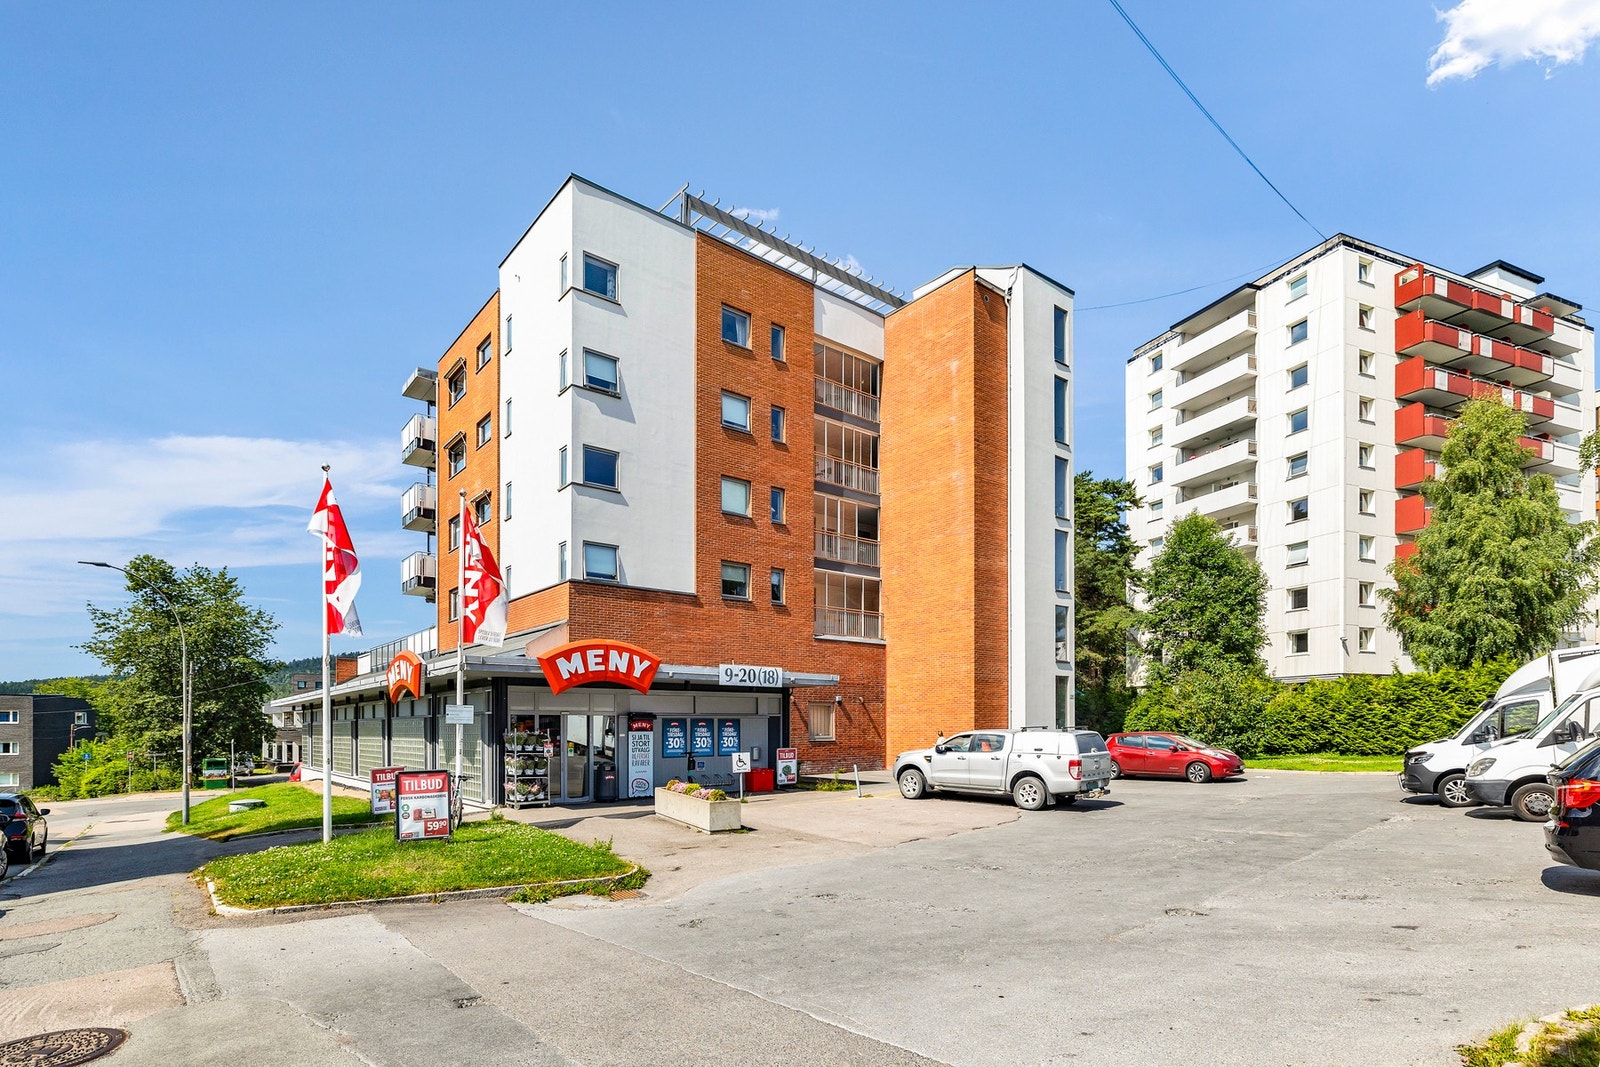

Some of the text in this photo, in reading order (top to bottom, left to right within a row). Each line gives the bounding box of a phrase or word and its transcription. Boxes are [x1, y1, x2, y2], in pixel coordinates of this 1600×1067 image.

[555, 649, 652, 680] MENY
[388, 659, 414, 690] MENY
[724, 667, 779, 686] 9-20(18)
[376, 772, 396, 781] TILBU
[403, 778, 443, 791] TILBUD
